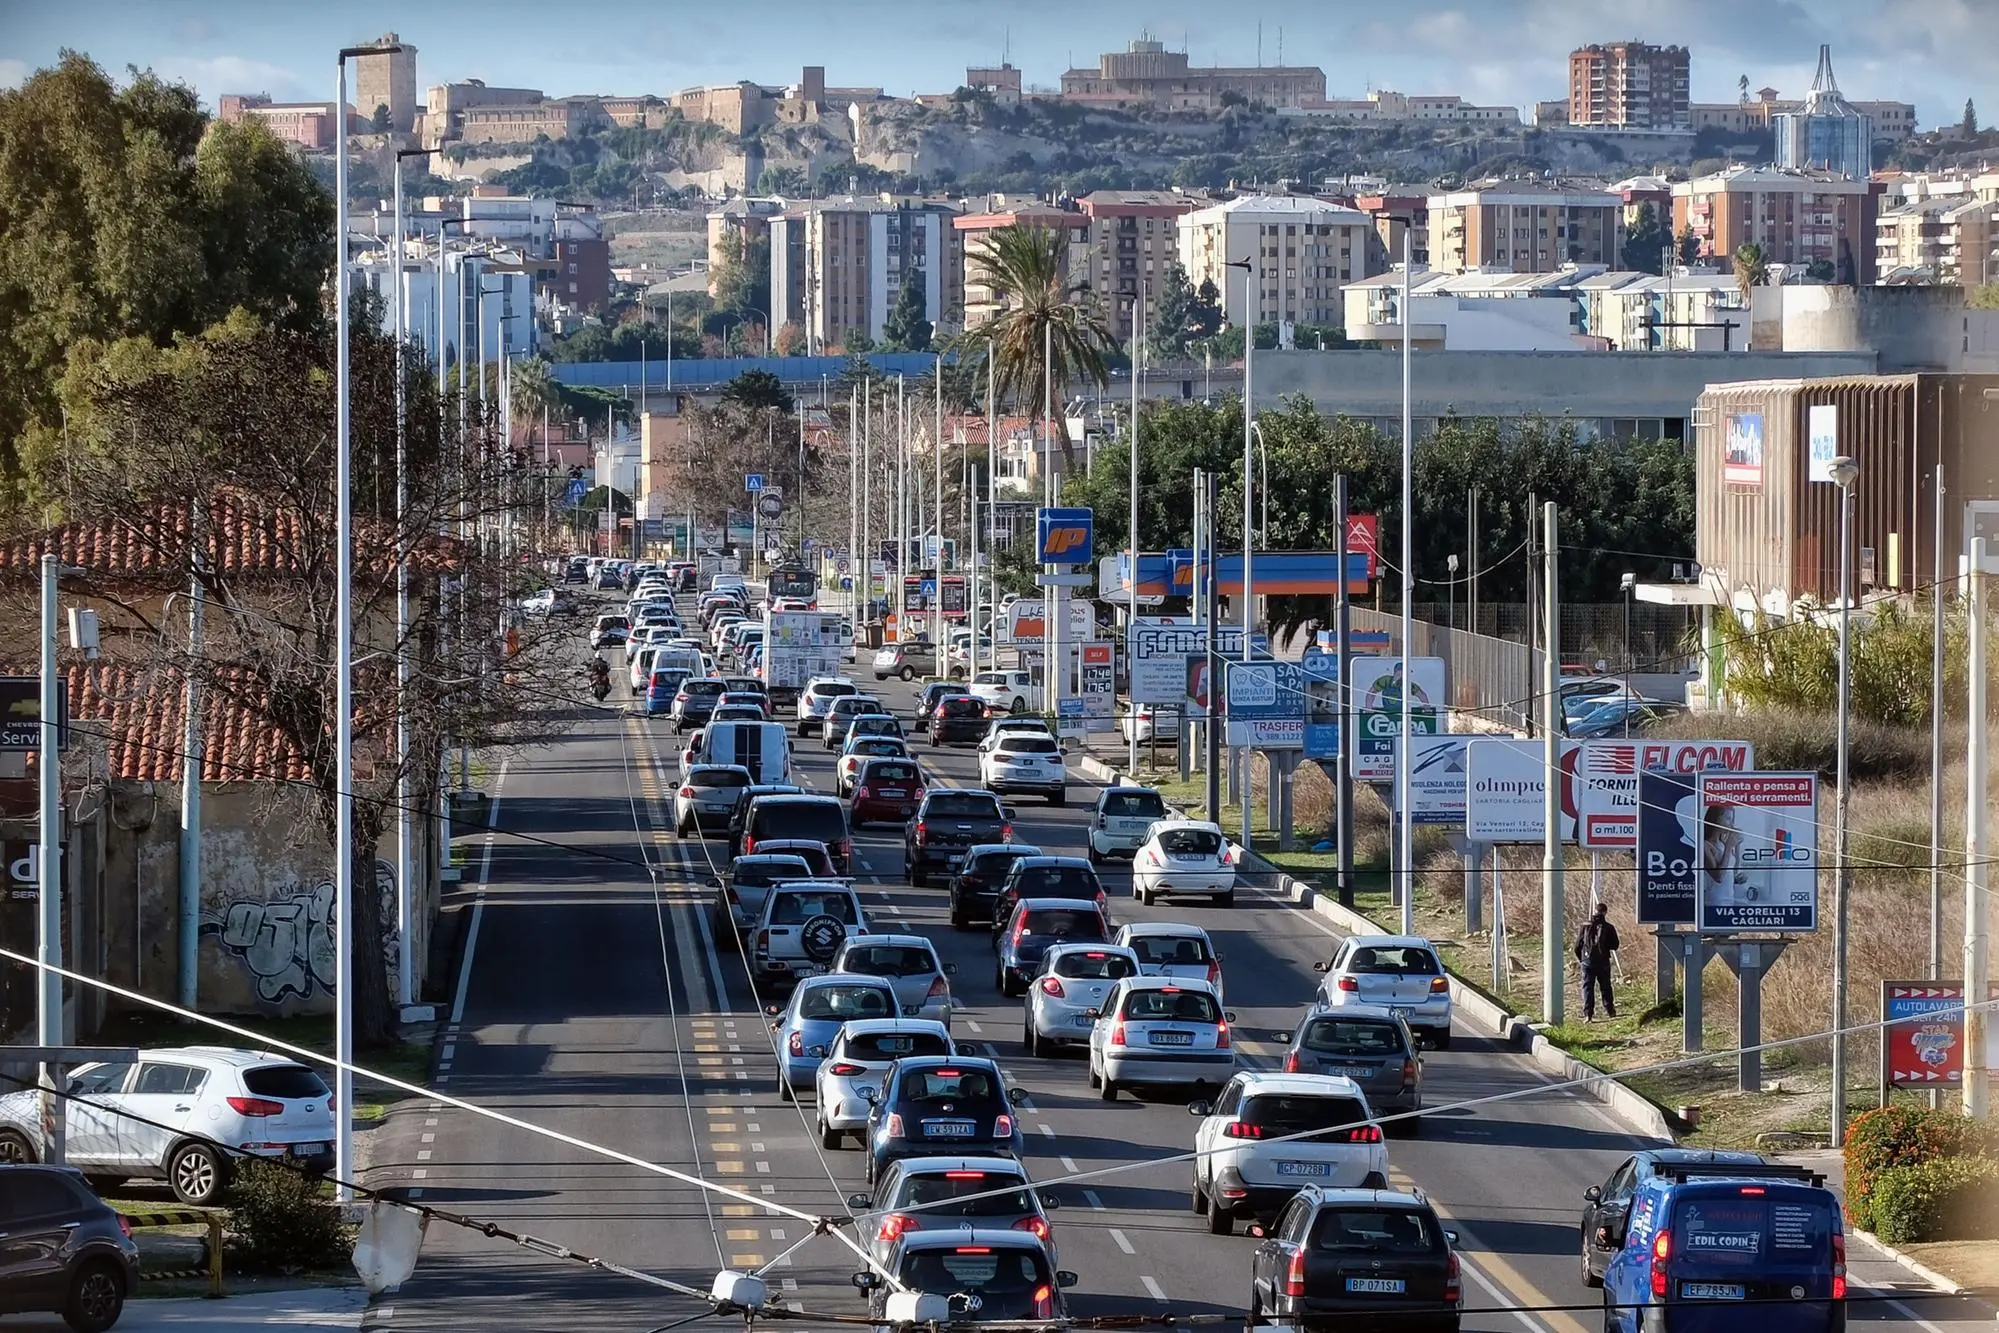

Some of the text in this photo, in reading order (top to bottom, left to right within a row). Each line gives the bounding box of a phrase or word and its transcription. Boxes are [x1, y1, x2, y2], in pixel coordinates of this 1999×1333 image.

[1233, 688, 1273, 696] IMPIANTI
[1375, 741, 1391, 750] Fai
[1706, 781, 1751, 791] Rallenta
[1753, 783, 1760, 791] e
[1763, 782, 1796, 792] pensa
[1706, 793, 1811, 803] migliori serramenti.
[1648, 881, 1675, 891] Denti
[1716, 908, 1801, 916] VIA CORELLI 13
[1731, 918, 1785, 926] CAGLIARI
[1695, 1236, 1748, 1247] EDIL COPIN
[1352, 1280, 1364, 1291] BP
